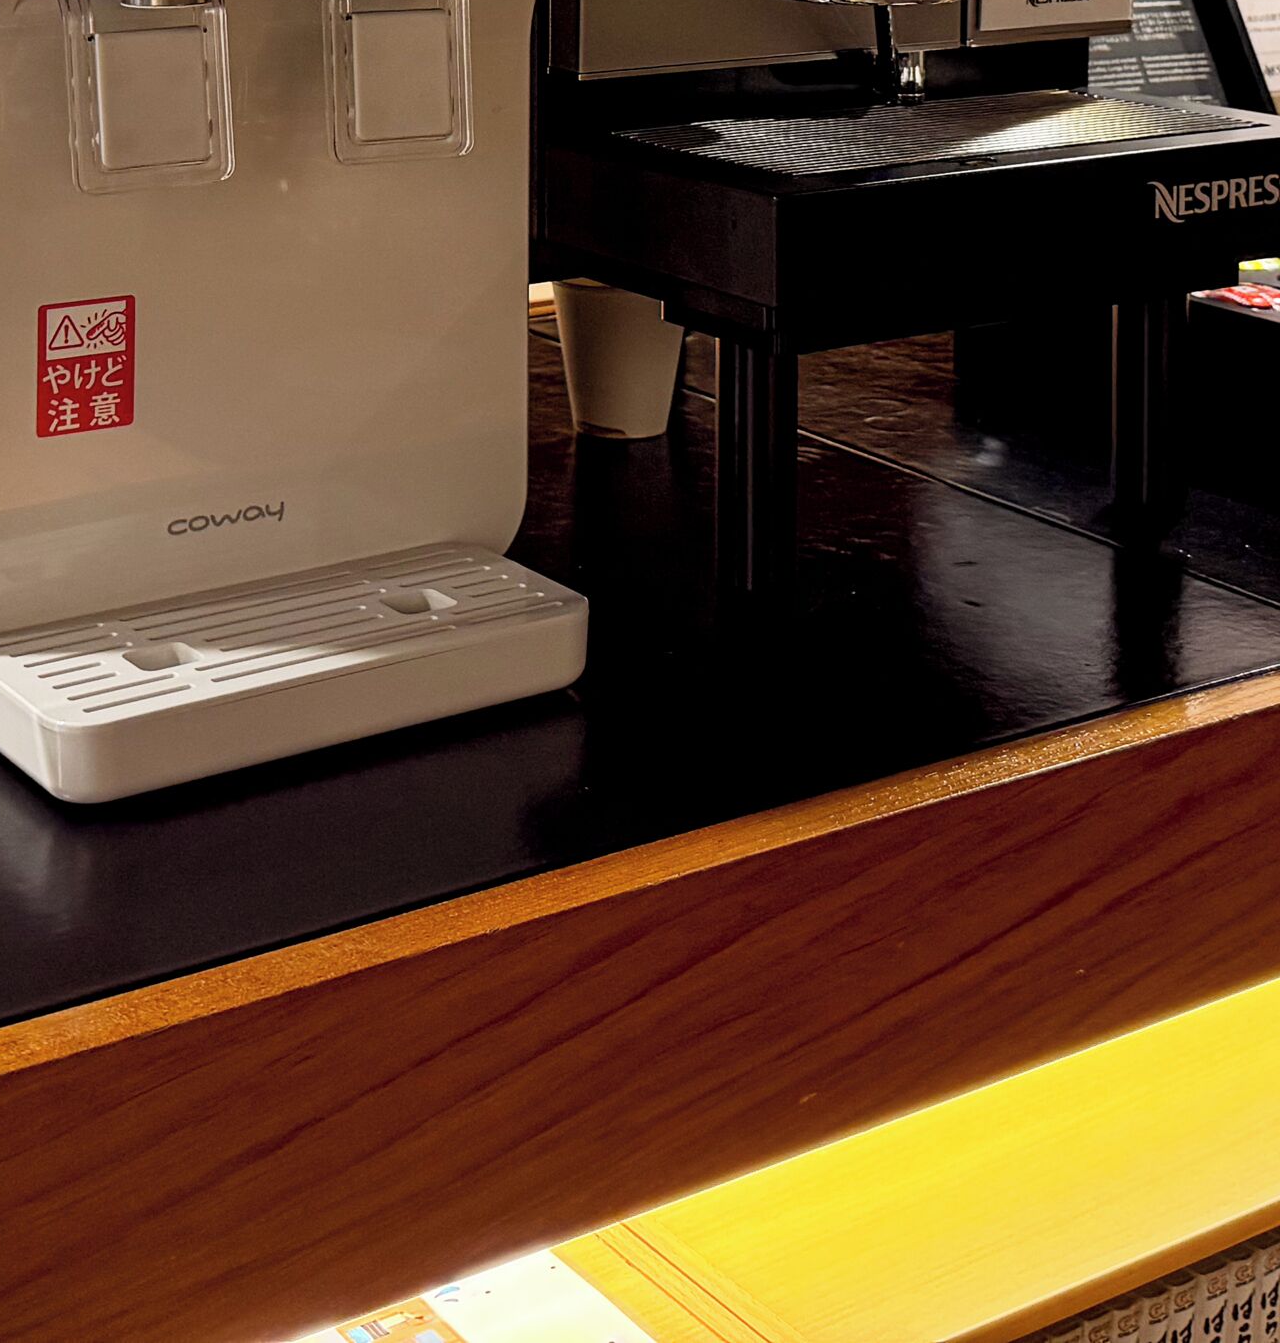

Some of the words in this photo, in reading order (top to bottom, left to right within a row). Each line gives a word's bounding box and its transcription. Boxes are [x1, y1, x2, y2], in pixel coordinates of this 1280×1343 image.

[42, 354, 128, 394] やけど
[48, 392, 121, 433] 注意
